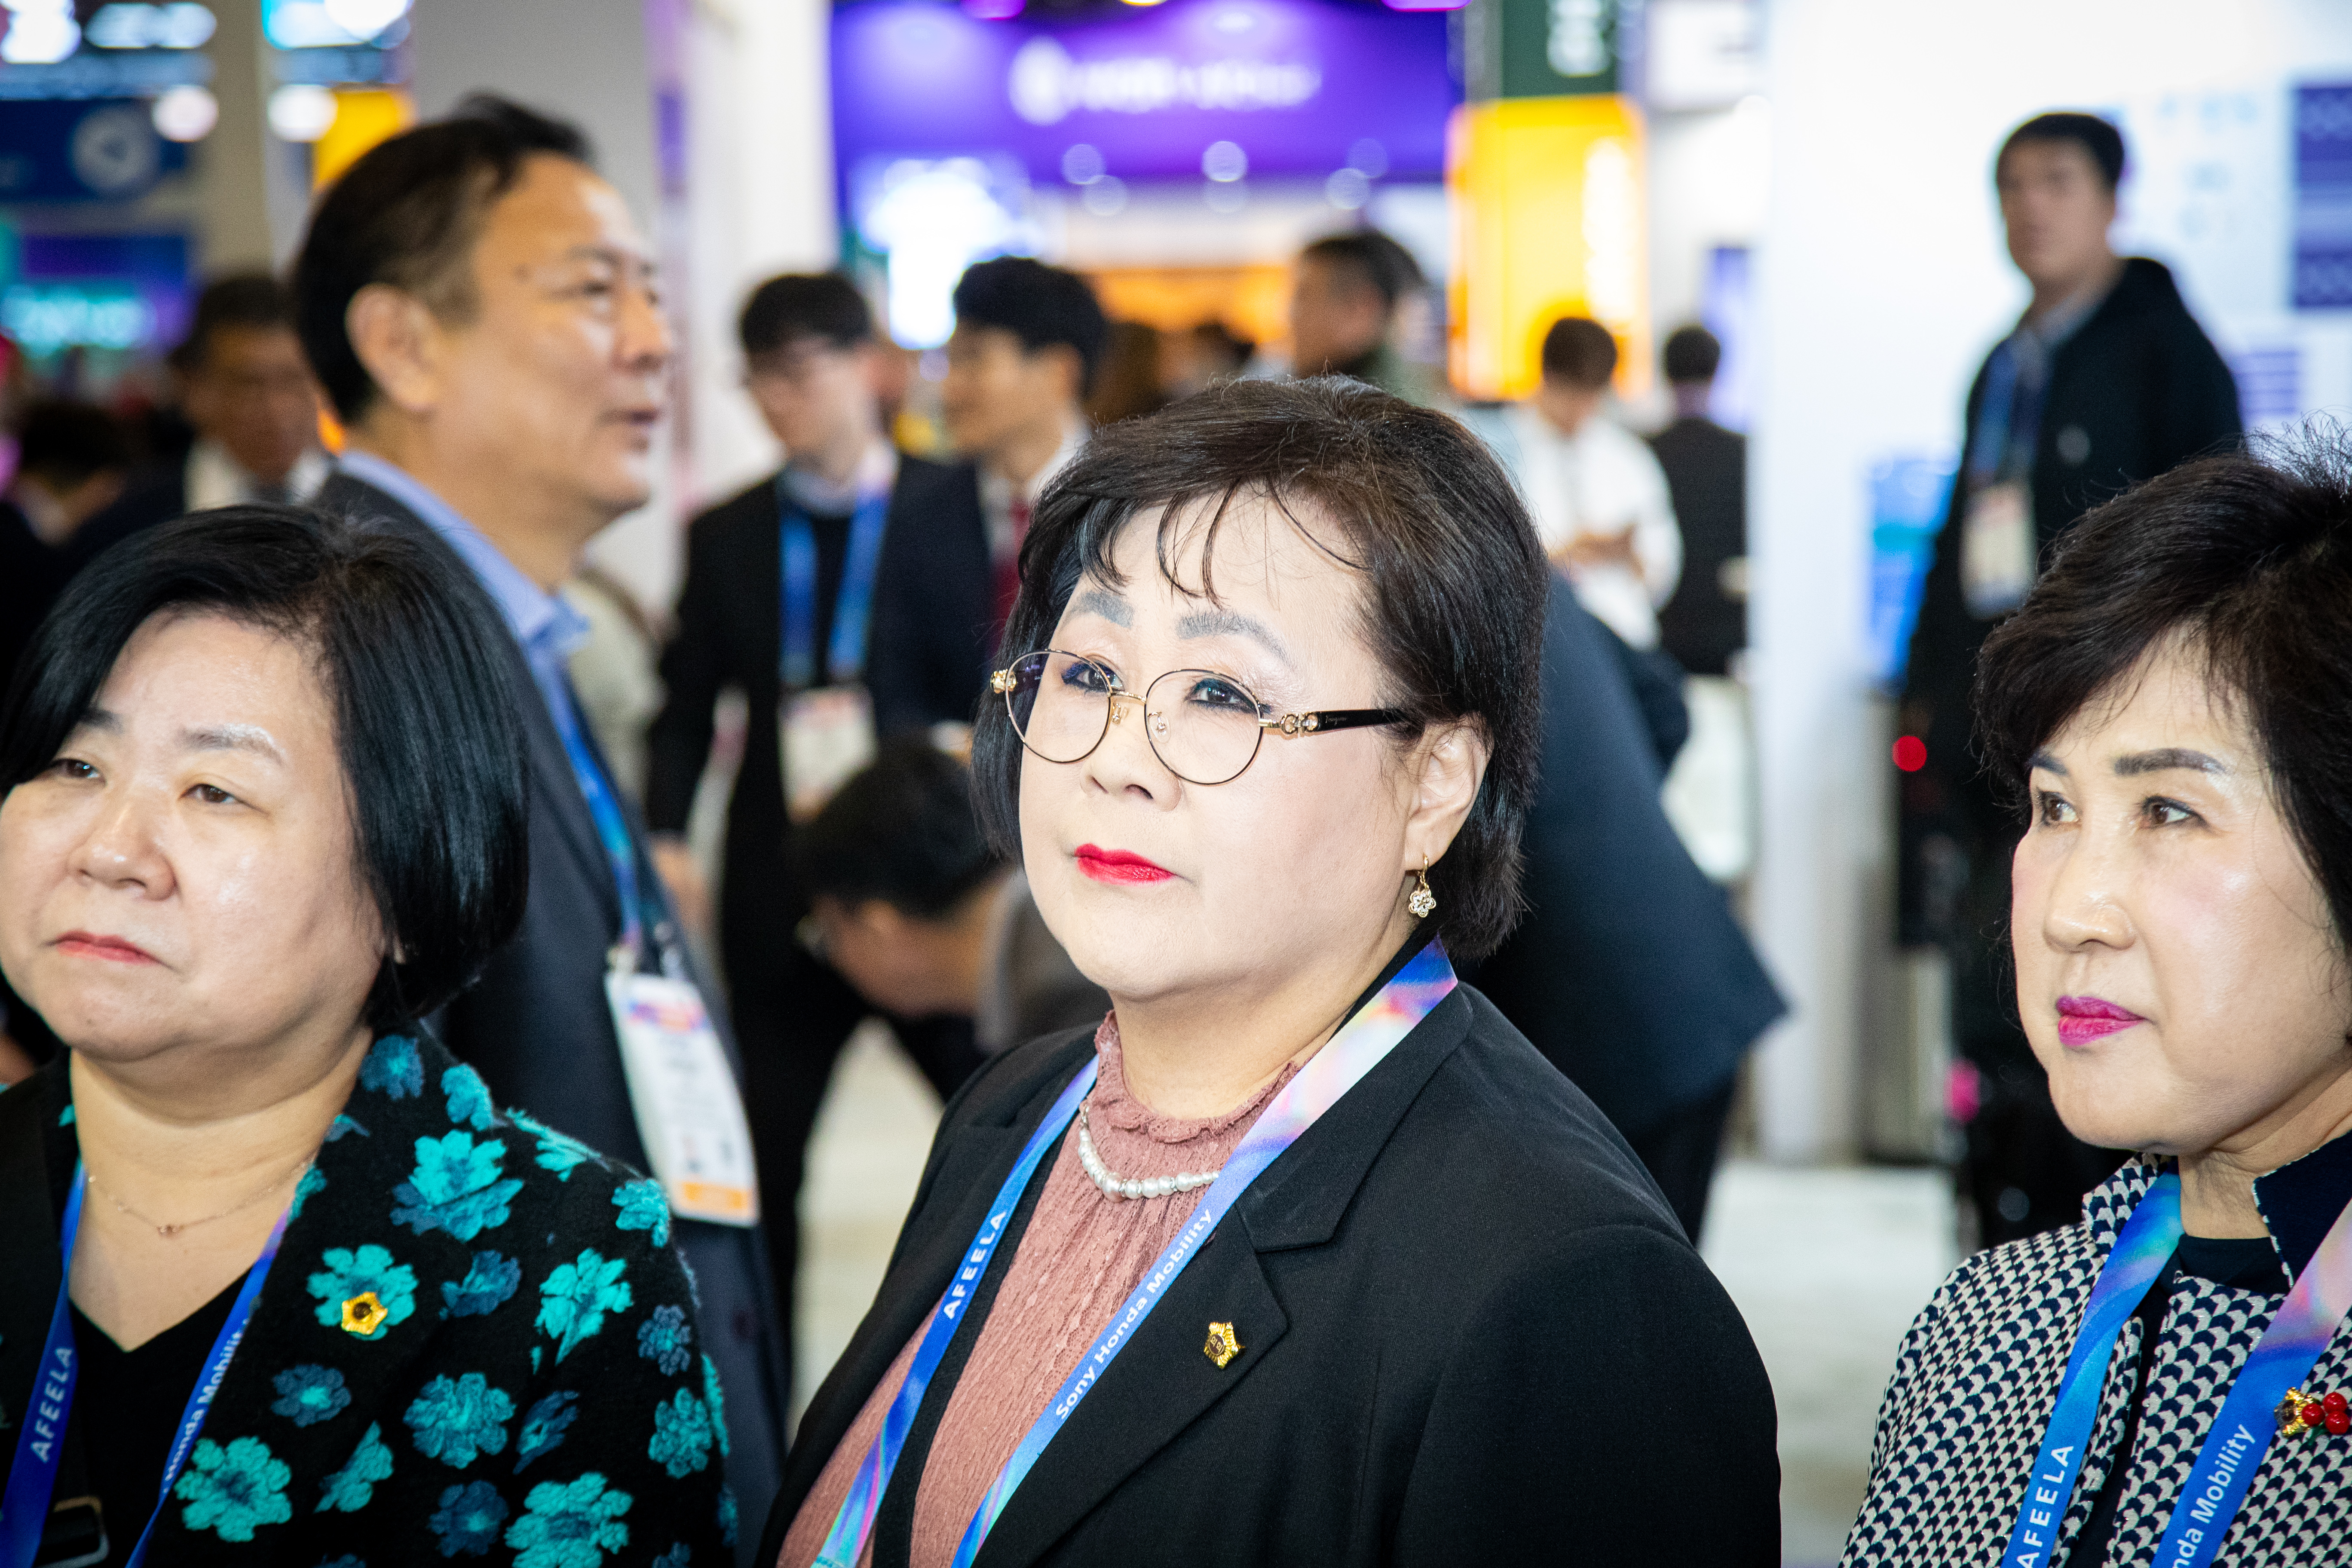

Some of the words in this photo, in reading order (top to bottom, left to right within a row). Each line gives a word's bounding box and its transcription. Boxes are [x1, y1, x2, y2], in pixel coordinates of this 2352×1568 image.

[944, 1211, 1006, 1320] AFEELA
[1056, 1366, 1096, 1419] Sony
[1094, 1297, 1148, 1364] Honda
[1146, 1209, 1212, 1293] Mobility
[31, 1348, 72, 1463] AFEELA
[196, 1318, 249, 1403] Mobilit
[2016, 1446, 2074, 1568] AFEELA
[2172, 1528, 2204, 1568] nda
[2190, 1424, 2256, 1524] Mobility
